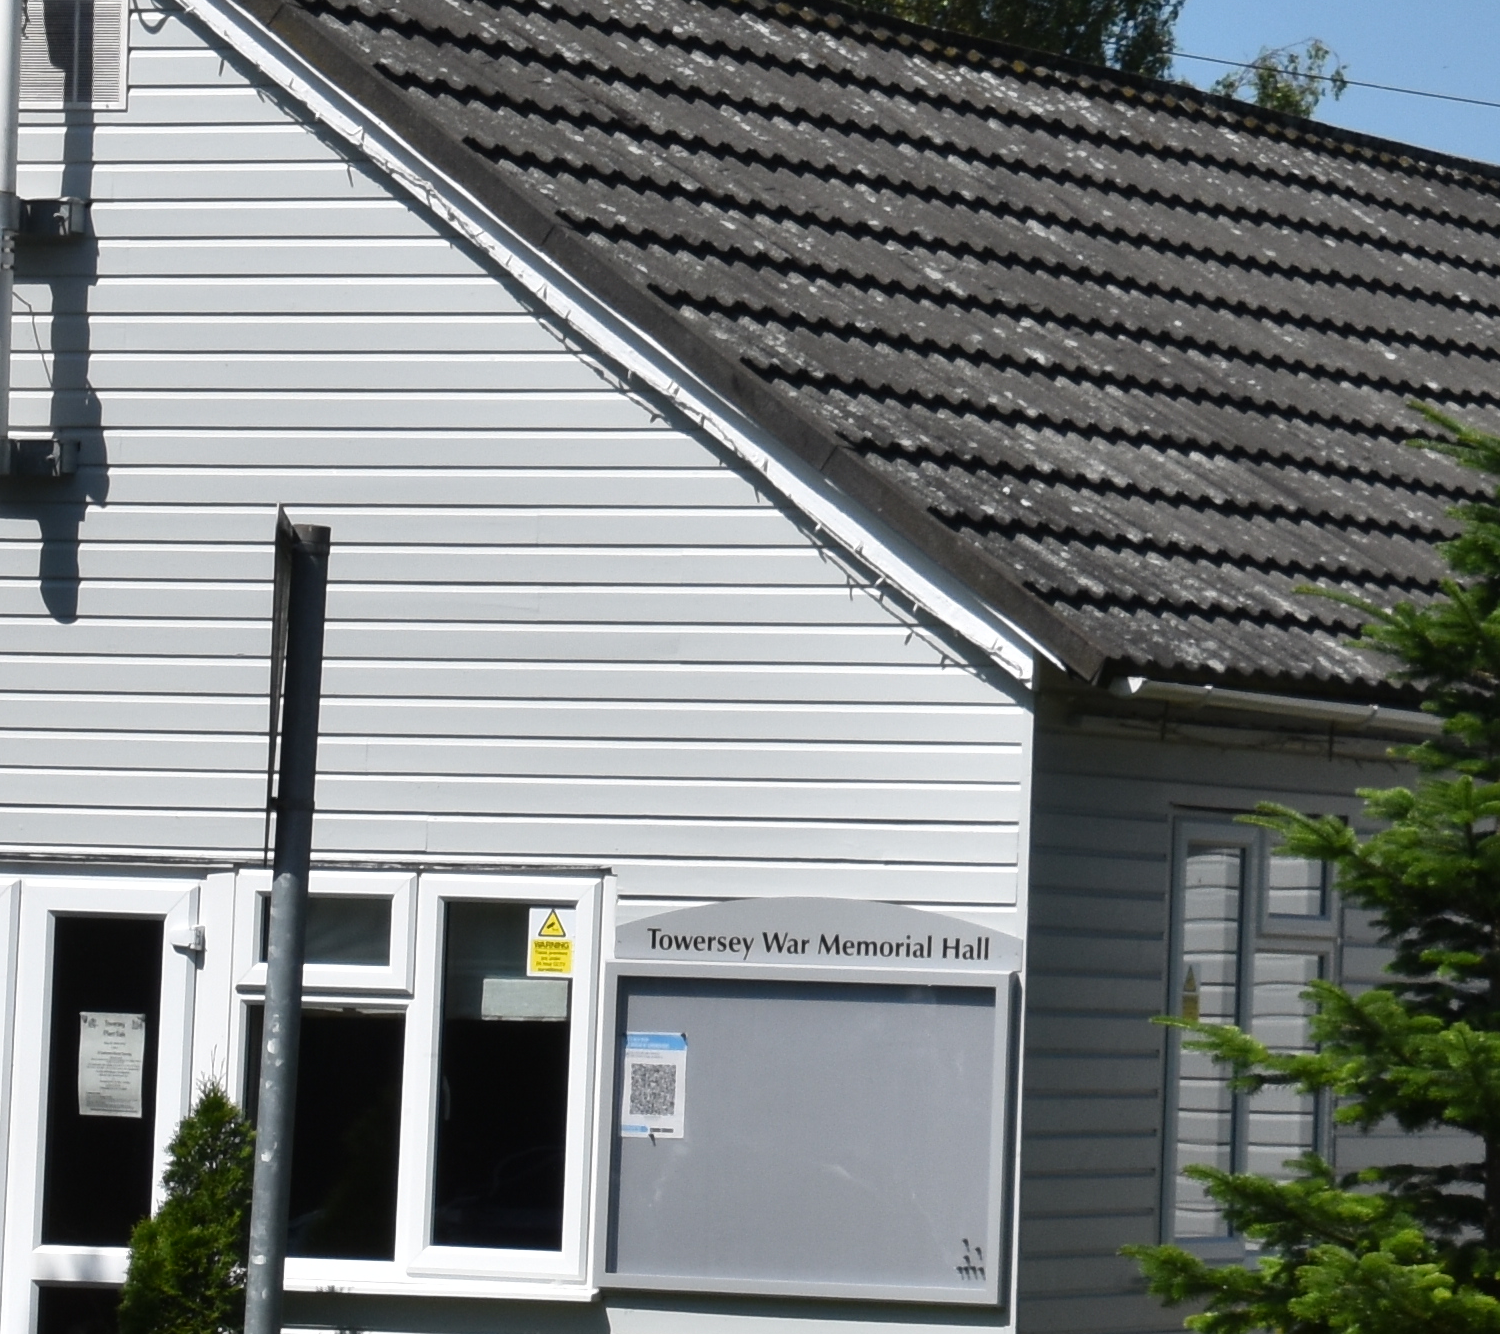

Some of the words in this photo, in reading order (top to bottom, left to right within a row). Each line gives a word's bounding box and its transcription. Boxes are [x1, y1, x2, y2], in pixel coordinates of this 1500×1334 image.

[534, 941, 570, 950] WARNING
[647, 928, 755, 960] Towersey
[762, 931, 810, 955] War
[818, 934, 933, 959] Memorial
[942, 937, 991, 961] Hall
